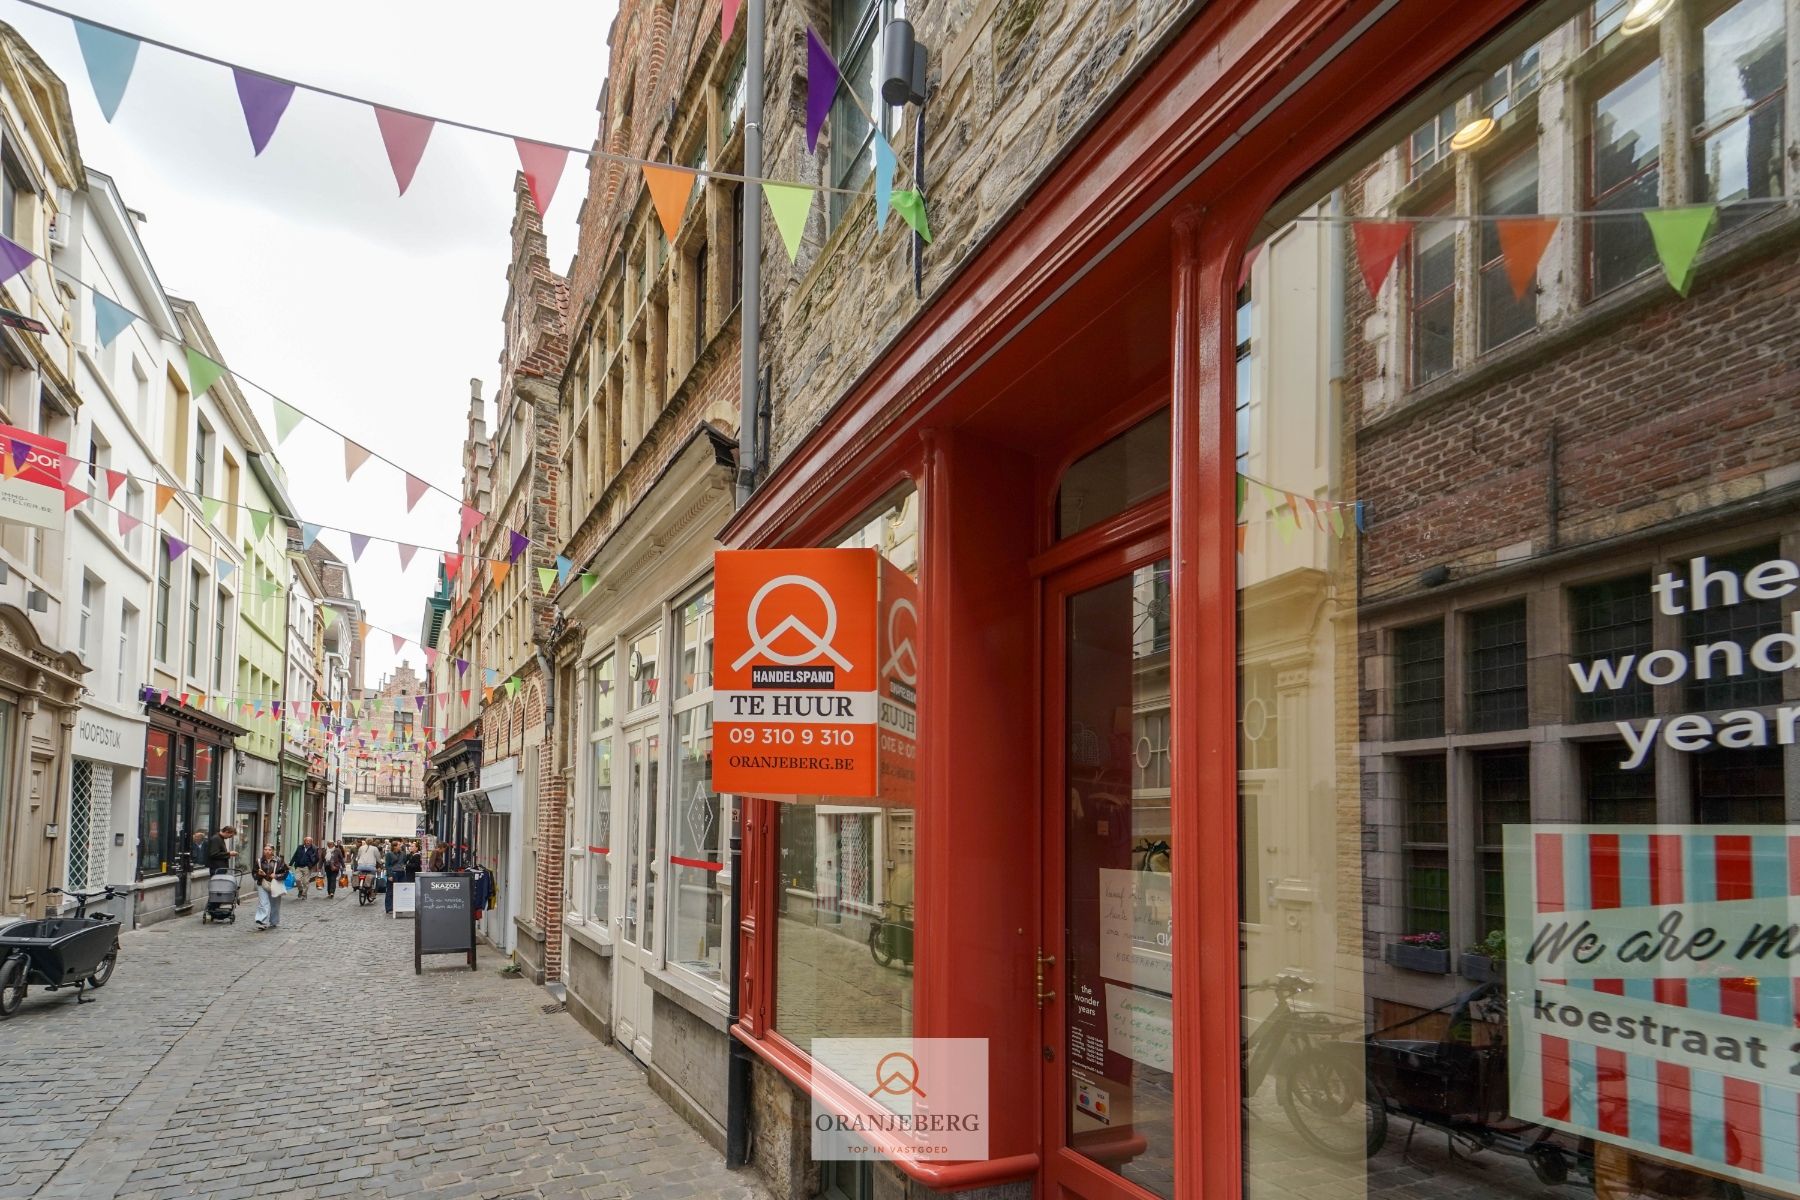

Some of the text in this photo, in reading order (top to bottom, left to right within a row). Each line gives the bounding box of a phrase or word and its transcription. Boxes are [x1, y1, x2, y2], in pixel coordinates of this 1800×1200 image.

[1652, 556, 1800, 616] the
[1568, 611, 1800, 693] wond
[753, 670, 834, 683] HANDELSPAND
[729, 695, 854, 717] TE HUUR
[80, 720, 121, 749] HOOFDSTUK
[729, 728, 854, 746] 09 310 9 310
[729, 755, 854, 771] ORANJEBERG.BE
[1525, 920, 1607, 965] We
[1617, 910, 1727, 963] are
[1081, 985, 1092, 995] the
[1075, 994, 1100, 1007] wonder
[1078, 1006, 1096, 1016] years
[1534, 989, 1768, 1069] koestraat
